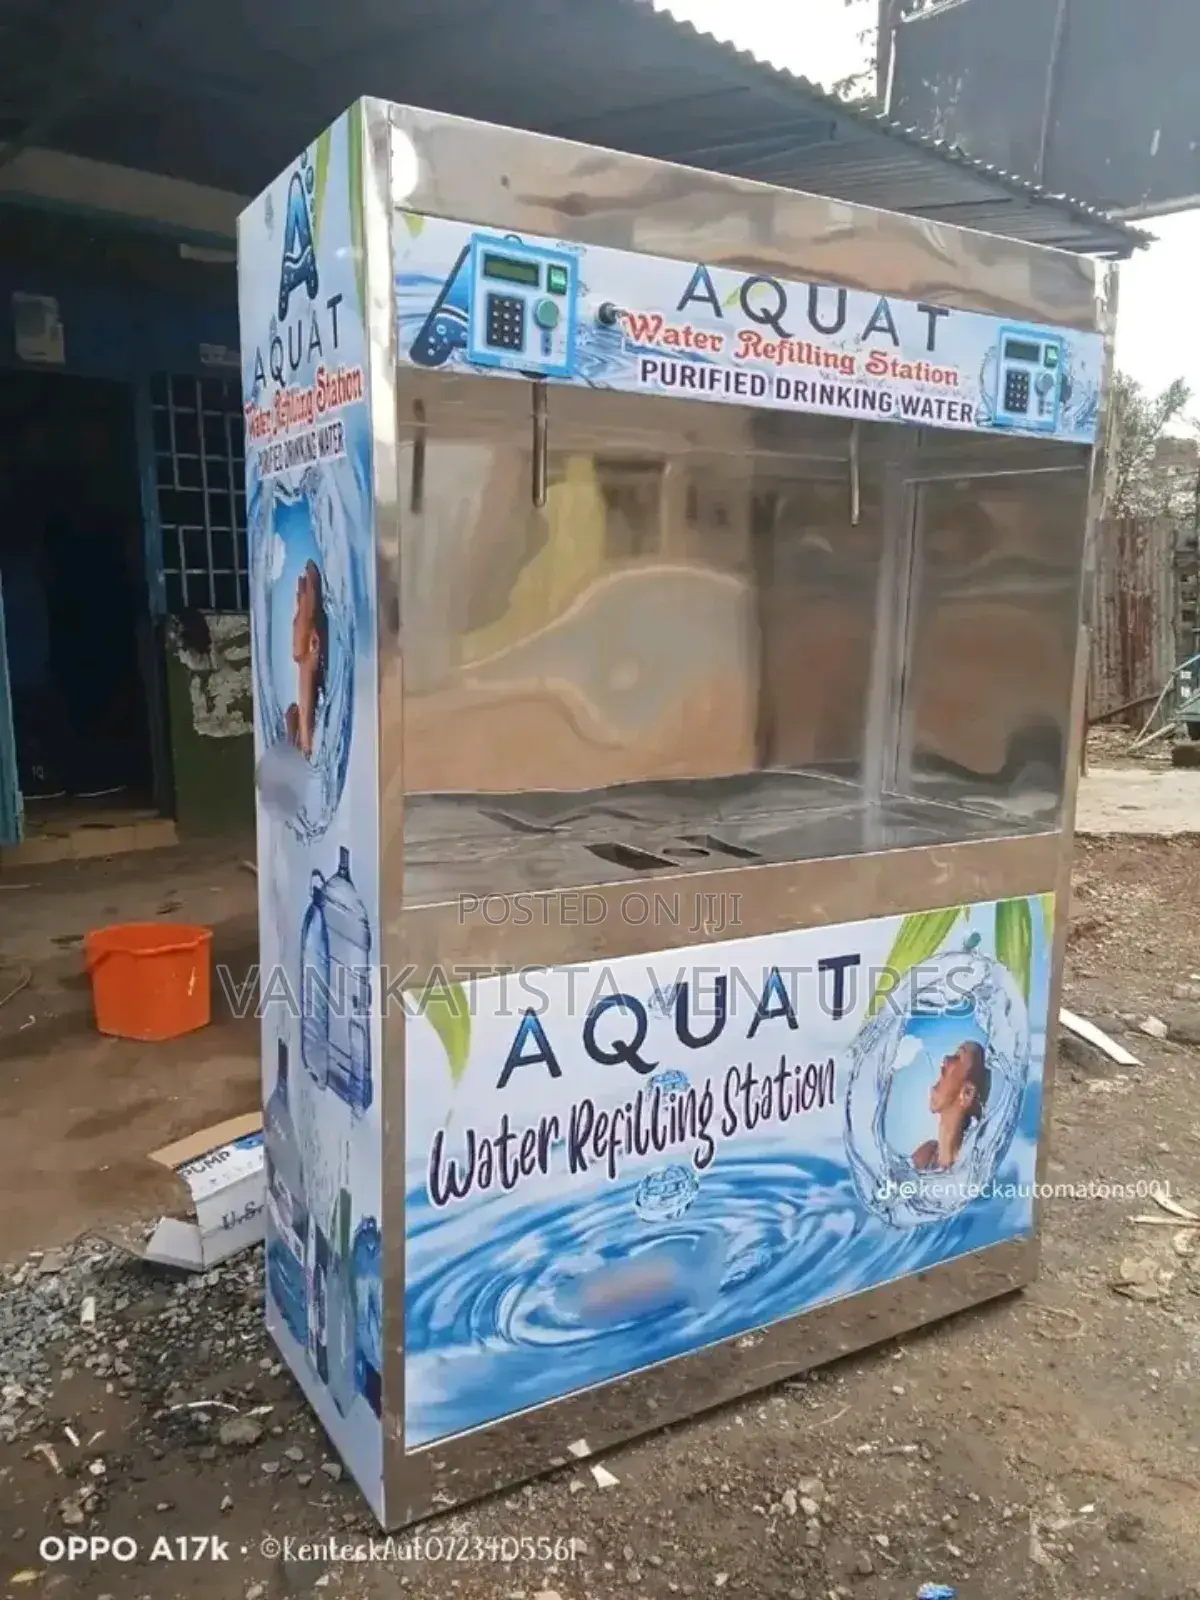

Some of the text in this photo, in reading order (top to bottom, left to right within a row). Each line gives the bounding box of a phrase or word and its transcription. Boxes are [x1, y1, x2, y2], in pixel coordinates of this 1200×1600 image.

[253, 293, 343, 388] AQUAT
[676, 261, 949, 352] AQUAT
[315, 364, 363, 413] Station
[622, 312, 959, 387] Water Refilling Station
[640, 359, 974, 424] PURIFIED DRINKING WATER
[317, 421, 345, 458] WATER
[496, 953, 861, 1089] AQUAT
[429, 1054, 836, 1206] Water Refilling Station
